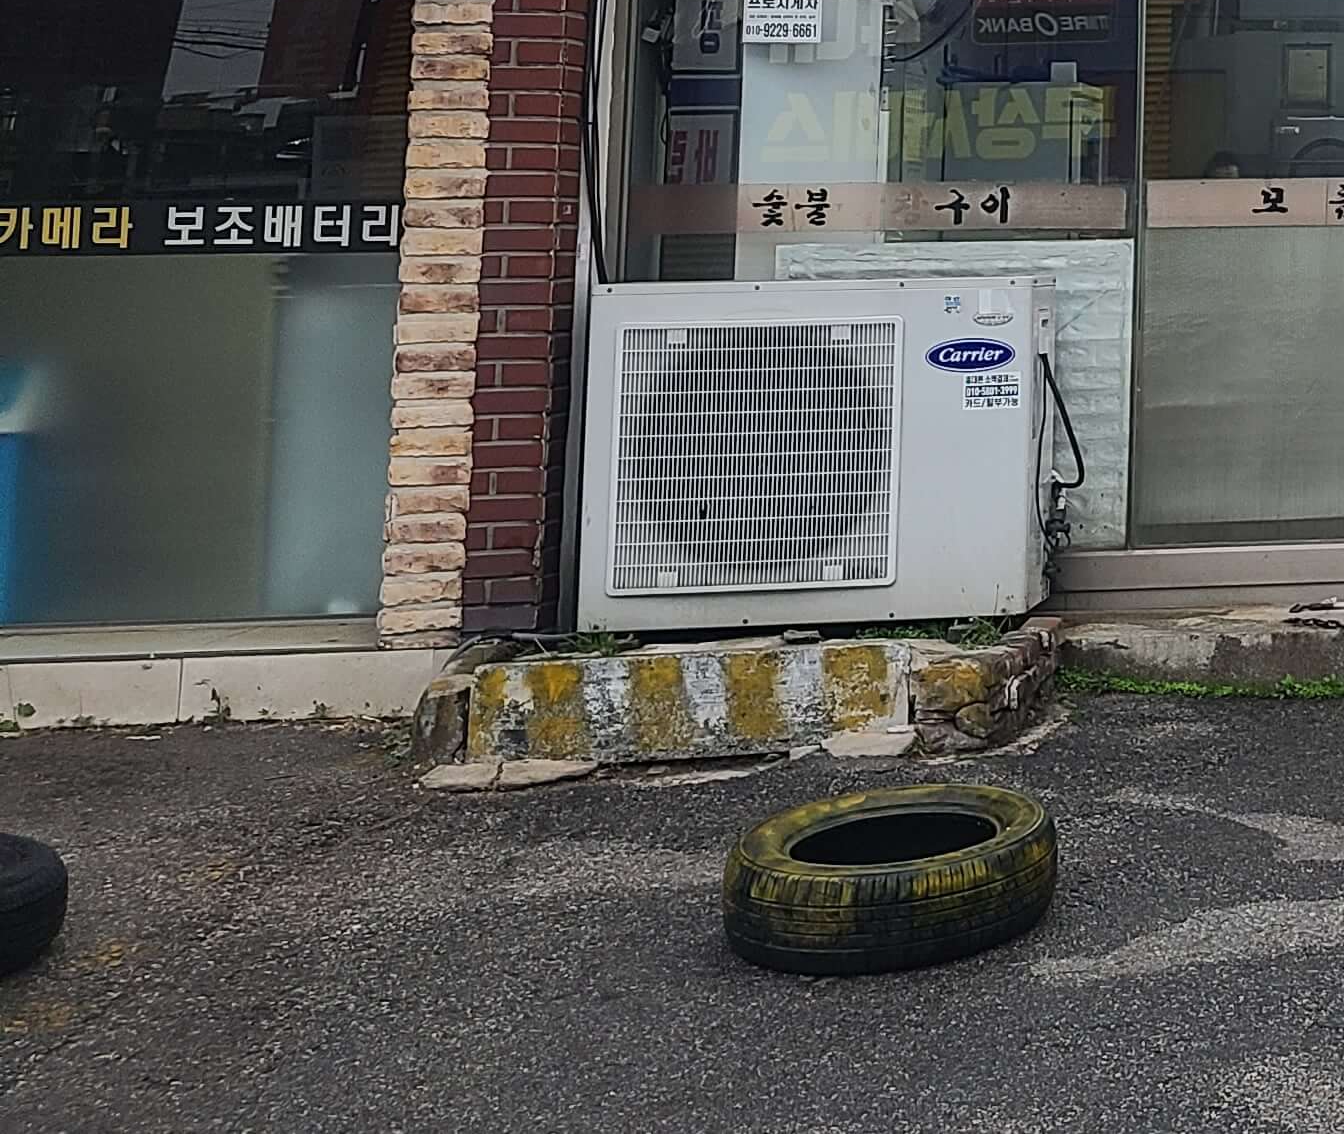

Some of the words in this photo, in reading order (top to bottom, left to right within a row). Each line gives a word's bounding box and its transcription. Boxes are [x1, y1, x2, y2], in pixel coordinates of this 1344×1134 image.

[746, 23, 818, 38] 010-9229-6661
[752, 188, 832, 227] 숯불
[934, 187, 1011, 225] 구이
[0, 205, 134, 250] 카메라
[163, 203, 400, 249] 보조배터리
[939, 346, 1004, 363] Carrier
